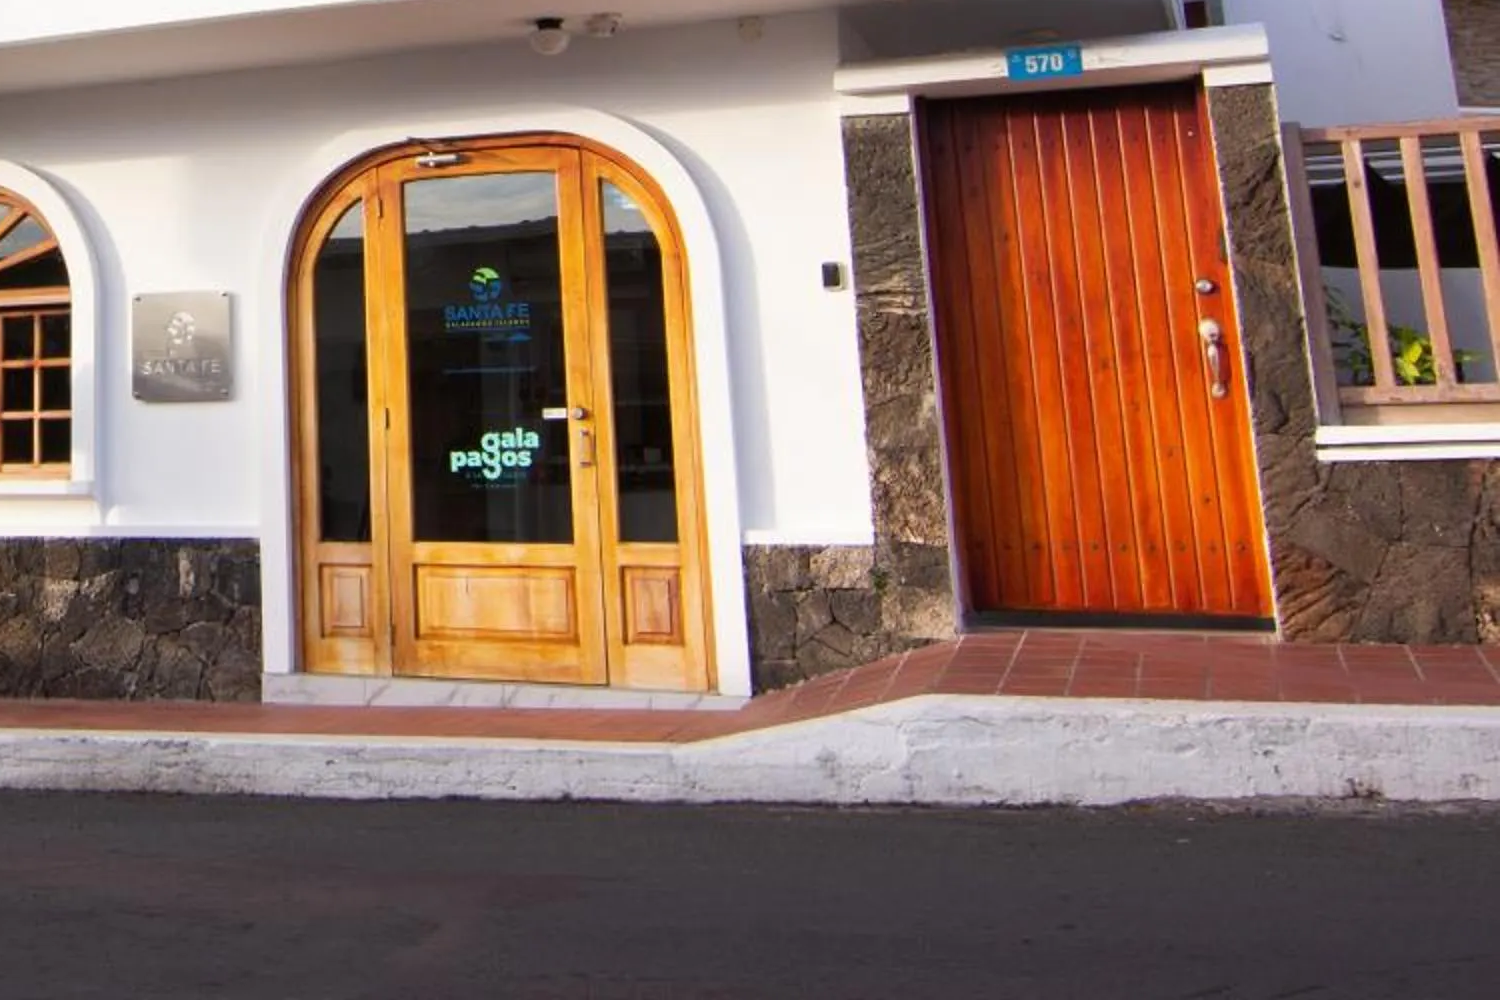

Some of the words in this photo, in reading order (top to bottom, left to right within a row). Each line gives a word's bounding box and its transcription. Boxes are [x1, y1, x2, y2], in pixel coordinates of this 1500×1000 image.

[1025, 53, 1064, 73] 570
[444, 304, 503, 320] SANTA
[506, 302, 530, 318] FE
[142, 360, 197, 375] SANTA
[480, 427, 540, 457] gala
[449, 450, 533, 480] pagos
